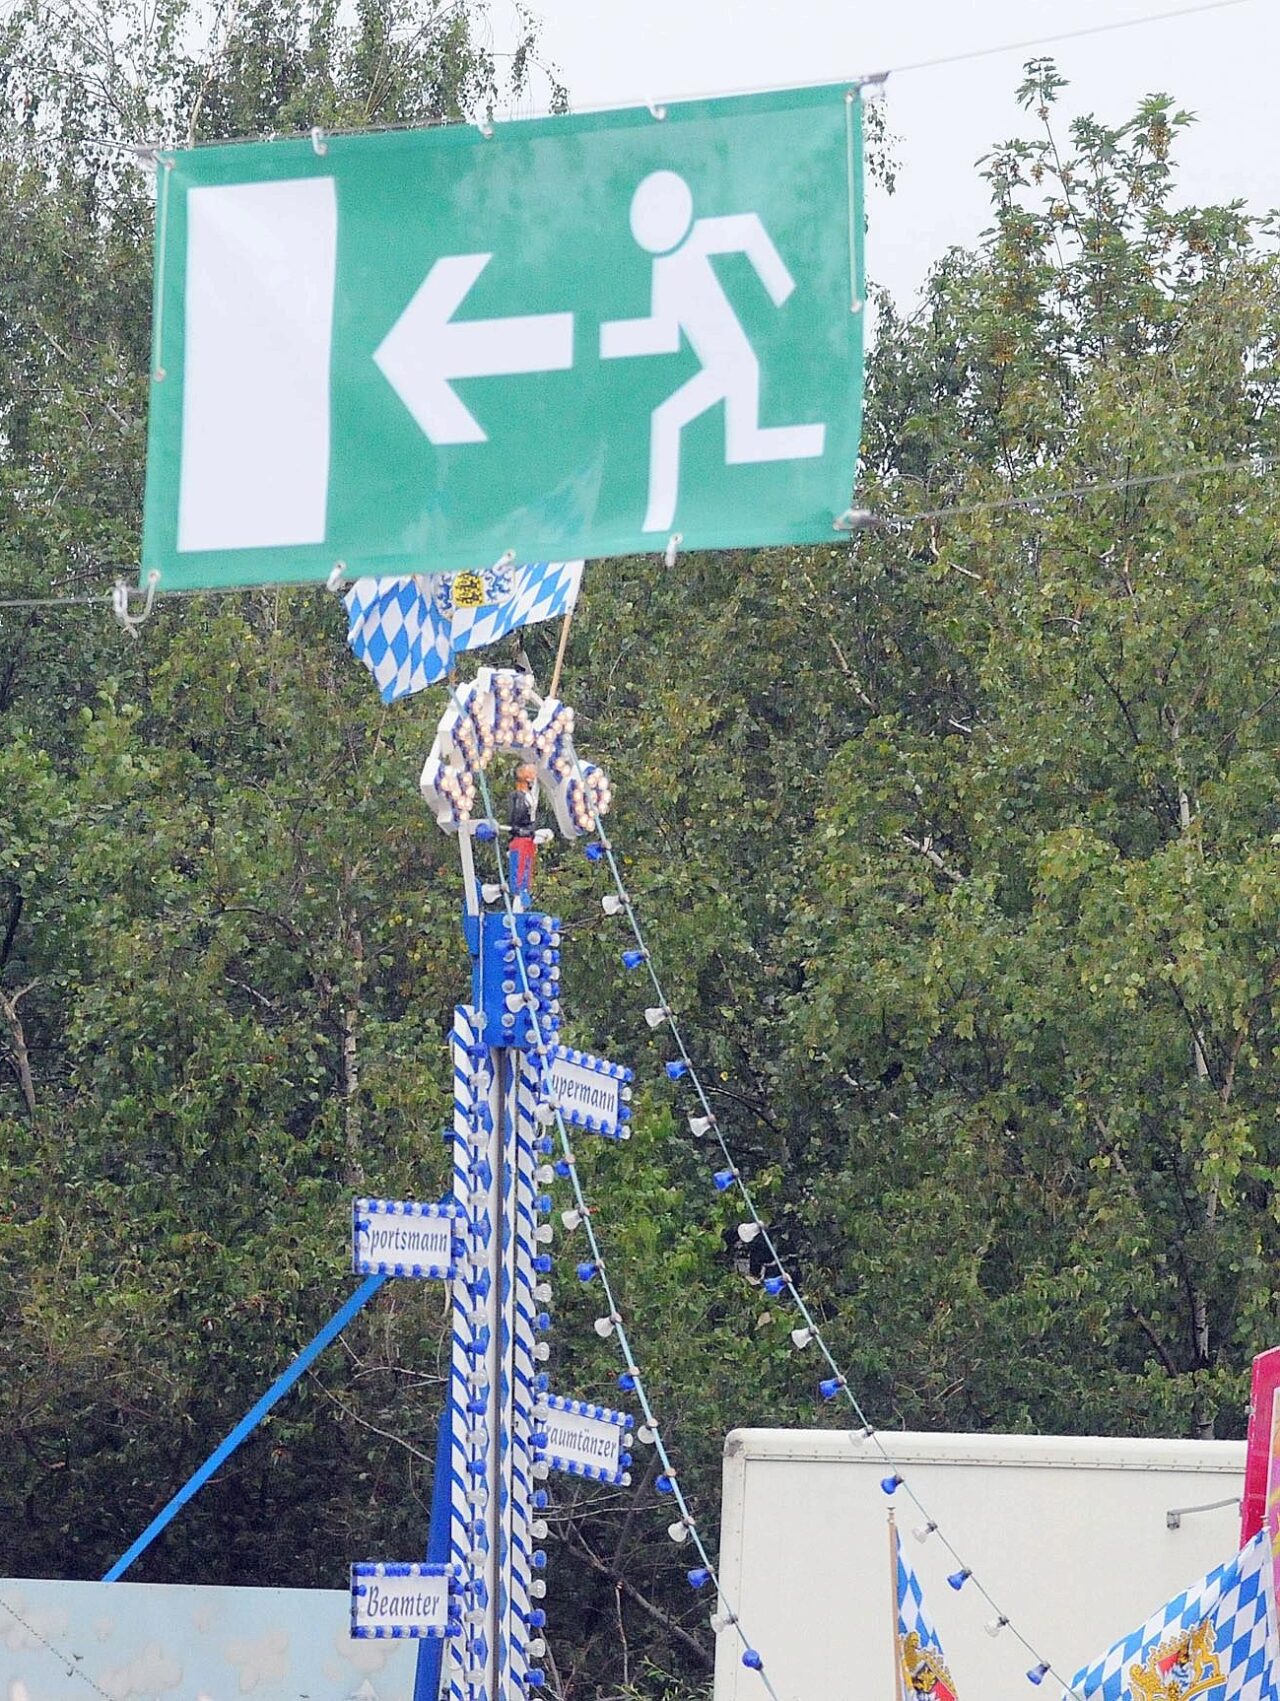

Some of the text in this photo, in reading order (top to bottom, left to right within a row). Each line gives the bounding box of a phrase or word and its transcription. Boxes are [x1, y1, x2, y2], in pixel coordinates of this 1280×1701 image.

[552, 1074, 615, 1113] upermann
[543, 1424, 617, 1459] raumtänzer
[367, 1585, 440, 1617] Beamter
